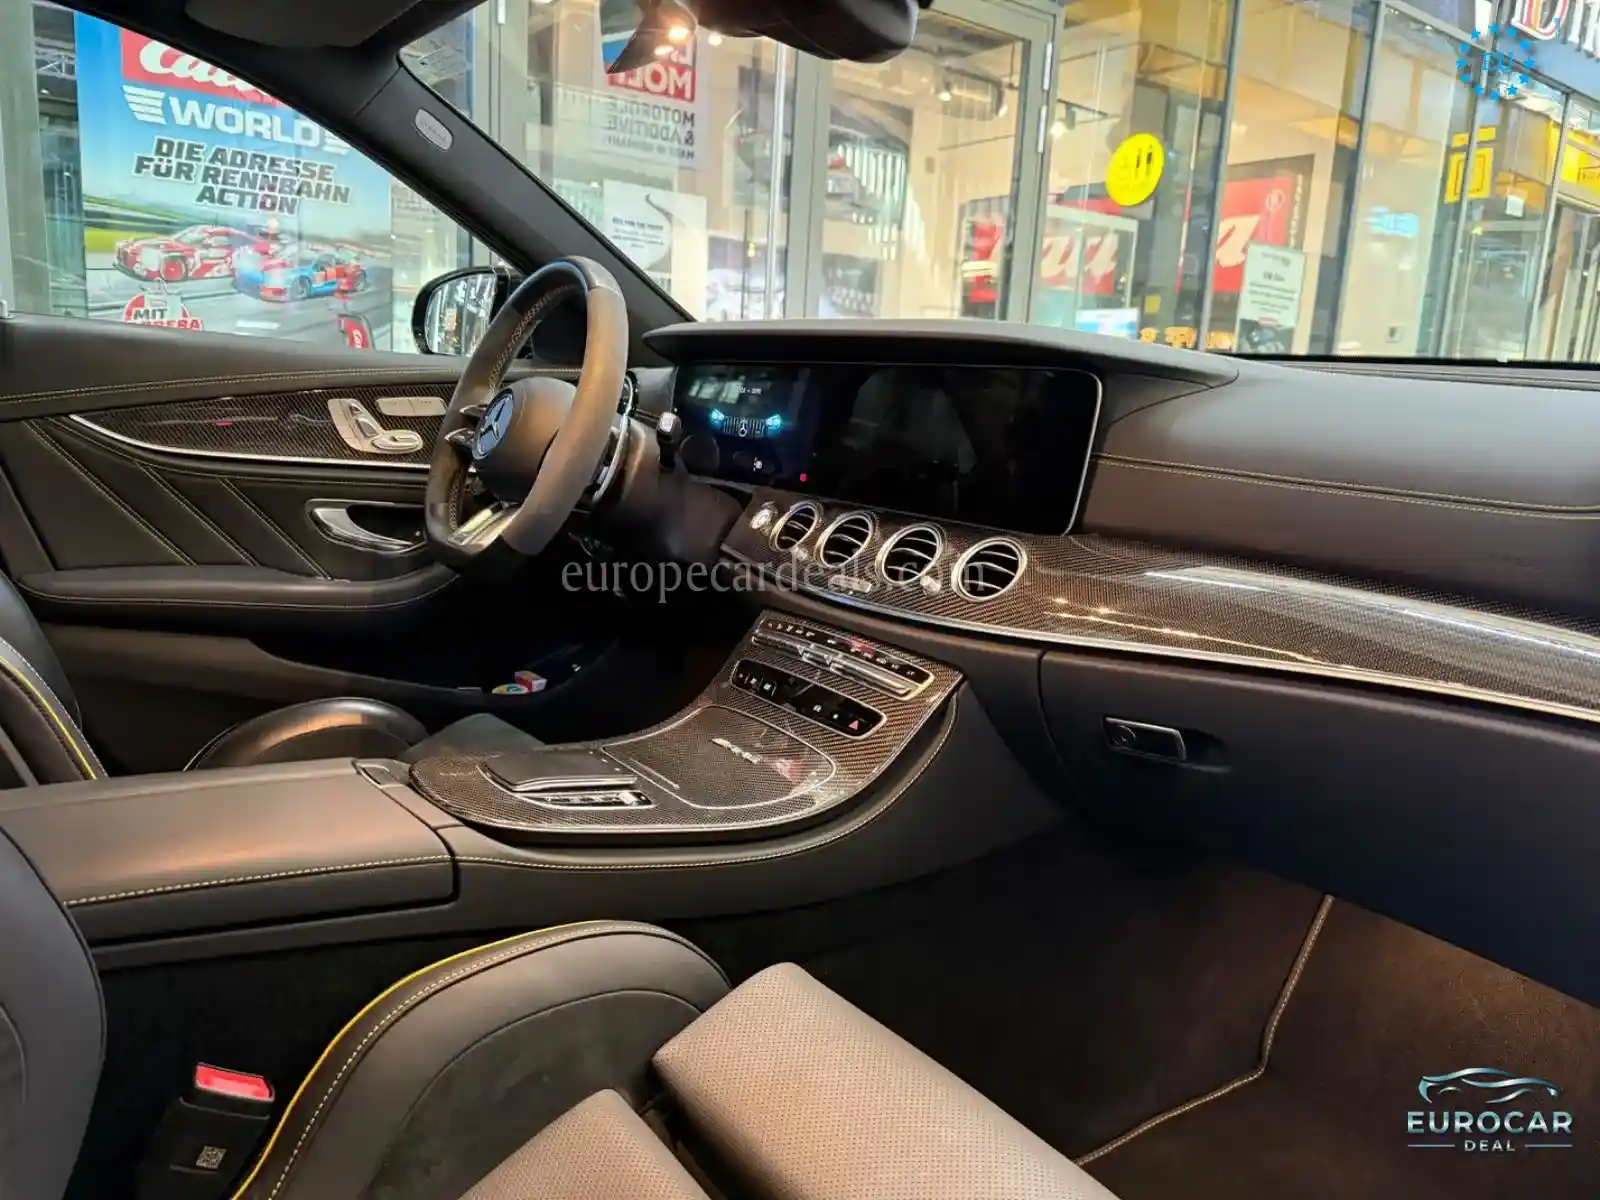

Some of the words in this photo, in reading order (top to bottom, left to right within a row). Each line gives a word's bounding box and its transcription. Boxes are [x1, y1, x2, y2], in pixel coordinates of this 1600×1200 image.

[168, 96, 321, 147] WORLD
[134, 155, 196, 183] FÜR
[201, 165, 350, 204] RENNBAHN
[154, 138, 205, 162] DIE
[207, 147, 335, 182] ADRESSE
[196, 186, 299, 214] ACTION
[133, 308, 168, 320] MIT
